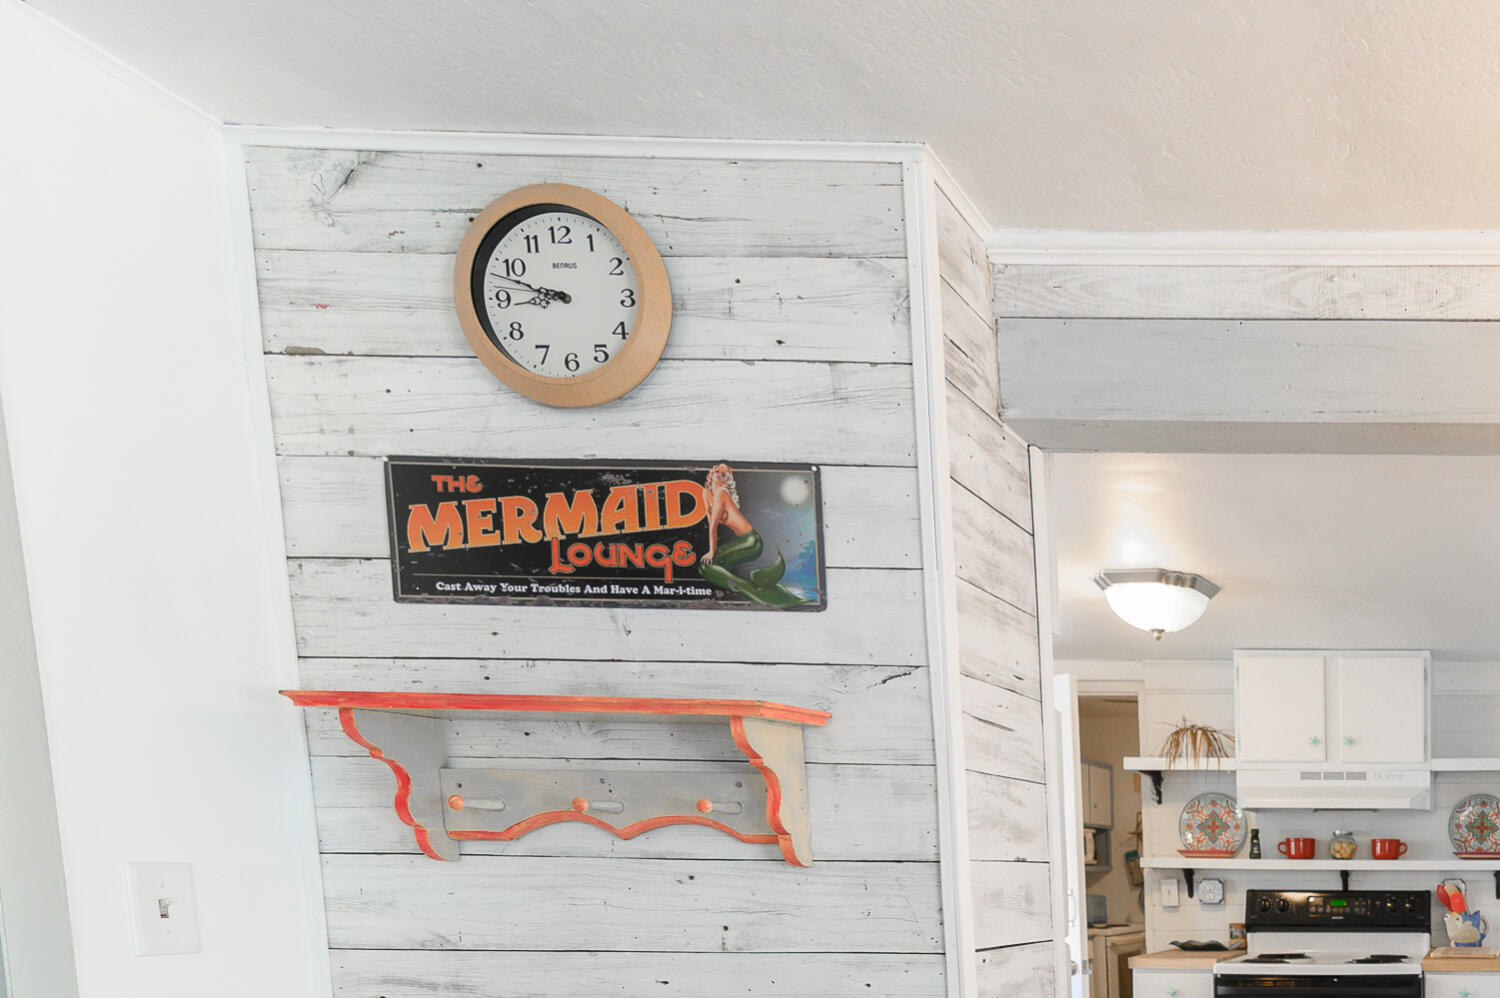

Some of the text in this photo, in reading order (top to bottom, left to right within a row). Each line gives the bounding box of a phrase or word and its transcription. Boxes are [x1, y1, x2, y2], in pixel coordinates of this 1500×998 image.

[524, 235, 540, 253] 11
[548, 226, 573, 245] 12
[586, 234, 595, 252] 1
[503, 258, 526, 277] 10
[609, 257, 624, 276] 2
[495, 290, 511, 309] 9
[620, 289, 636, 308] 3
[509, 322, 524, 340] 8
[612, 321, 629, 340] 4
[535, 345, 550, 365] 7
[564, 353, 580, 372] 6
[593, 344, 609, 363] 5
[431, 474, 483, 493] THE
[407, 480, 709, 553] MERMAID
[548, 537, 697, 584] LOUNGE
[435, 581, 712, 596] Cast Away Your Troubles And Have A Mar-i-time
